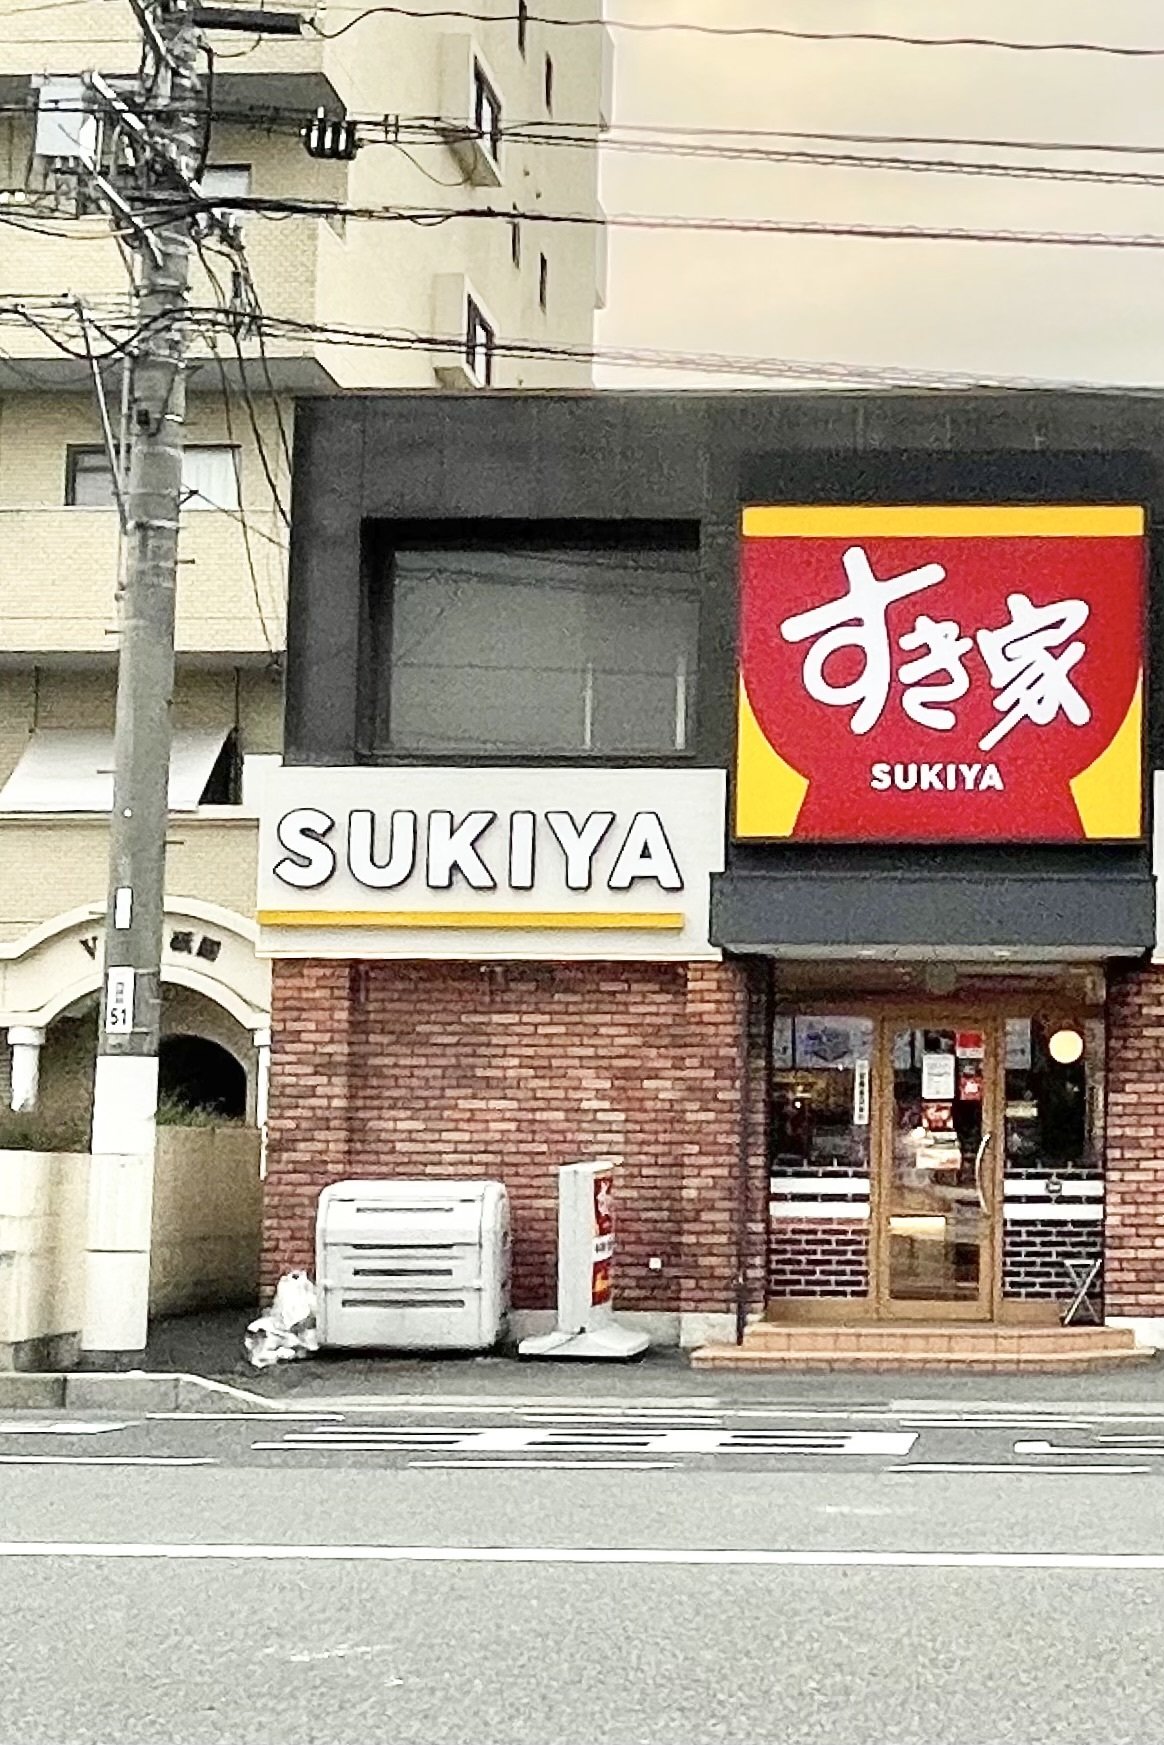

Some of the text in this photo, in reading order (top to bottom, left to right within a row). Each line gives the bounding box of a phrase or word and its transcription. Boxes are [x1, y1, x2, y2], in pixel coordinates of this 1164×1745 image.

[780, 546, 1092, 752] すき家
[870, 763, 1005, 791] SUKIYA
[272, 807, 685, 890] SUKIYA
